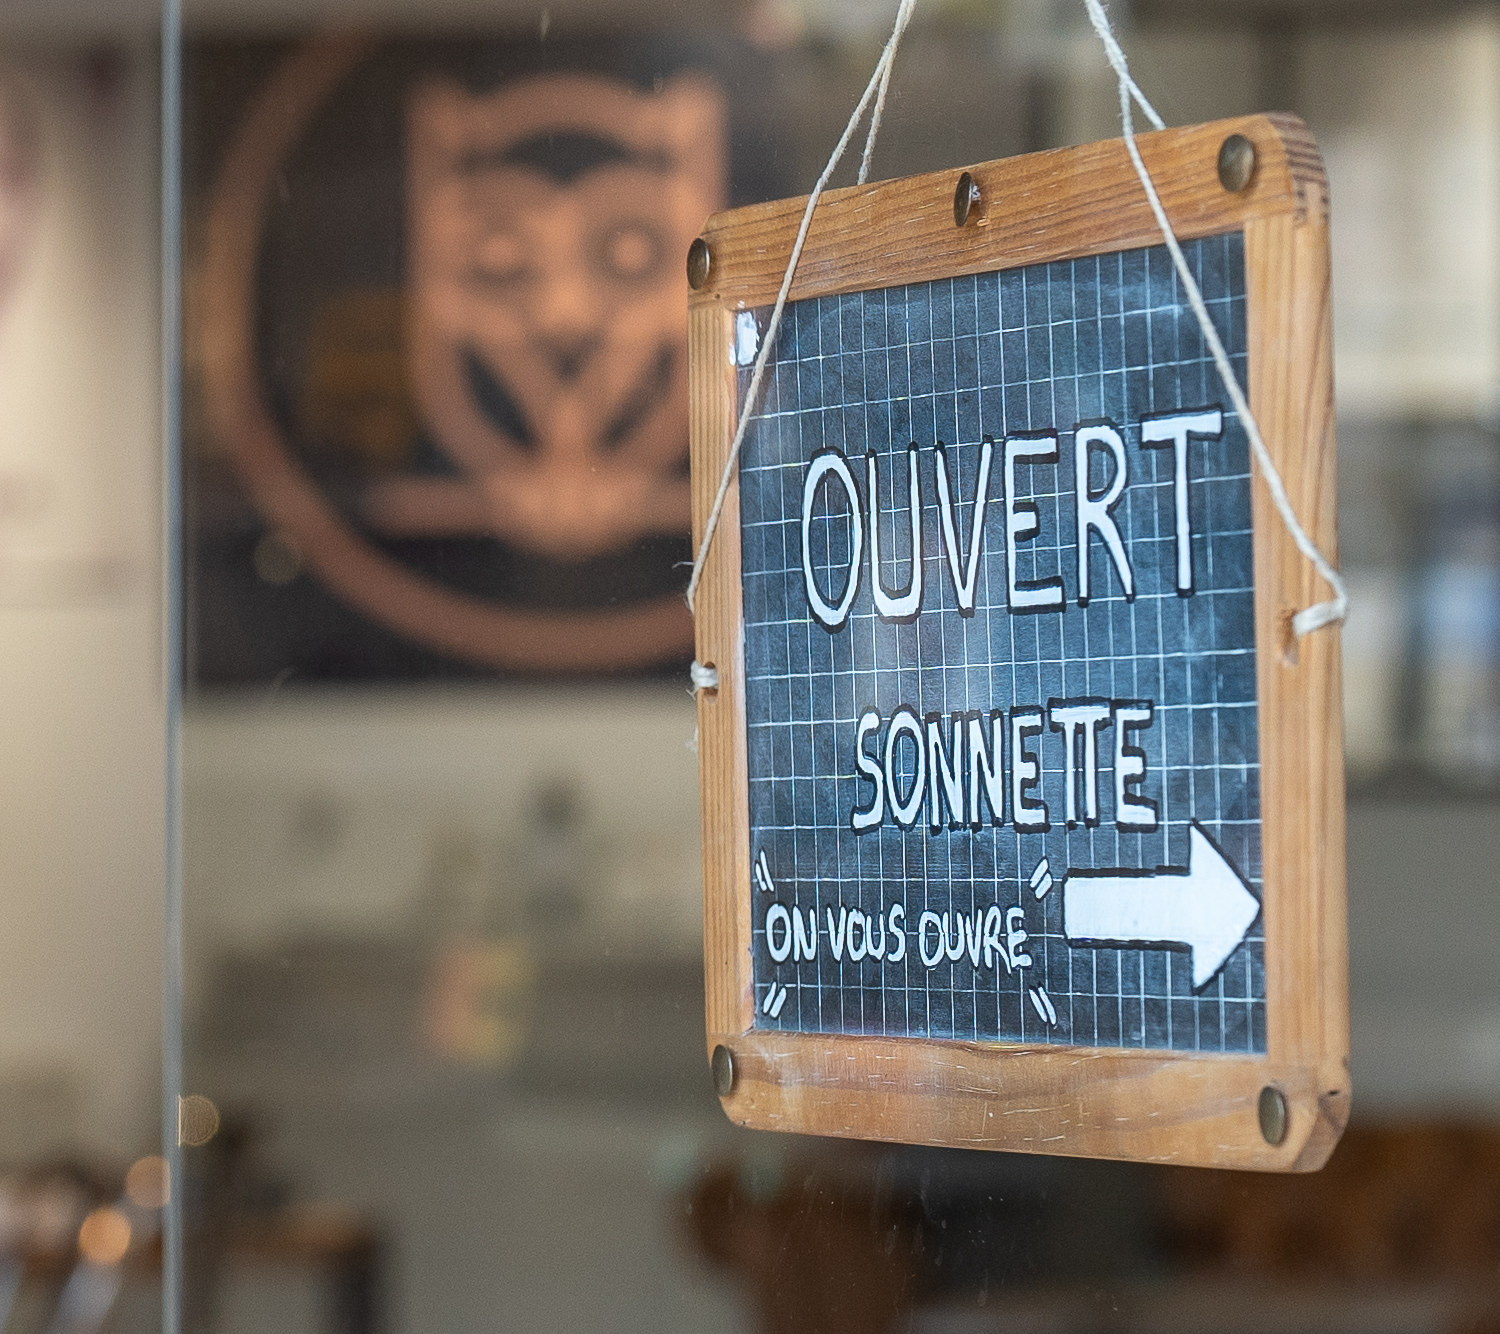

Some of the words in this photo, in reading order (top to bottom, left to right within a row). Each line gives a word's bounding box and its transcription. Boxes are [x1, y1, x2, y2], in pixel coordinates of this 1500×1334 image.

[801, 407, 1222, 631] OUVERT
[852, 697, 1159, 835] SONNETTE
[765, 903, 817, 963] ON
[826, 902, 906, 963] VOUS
[917, 904, 1033, 975] OUVRE
